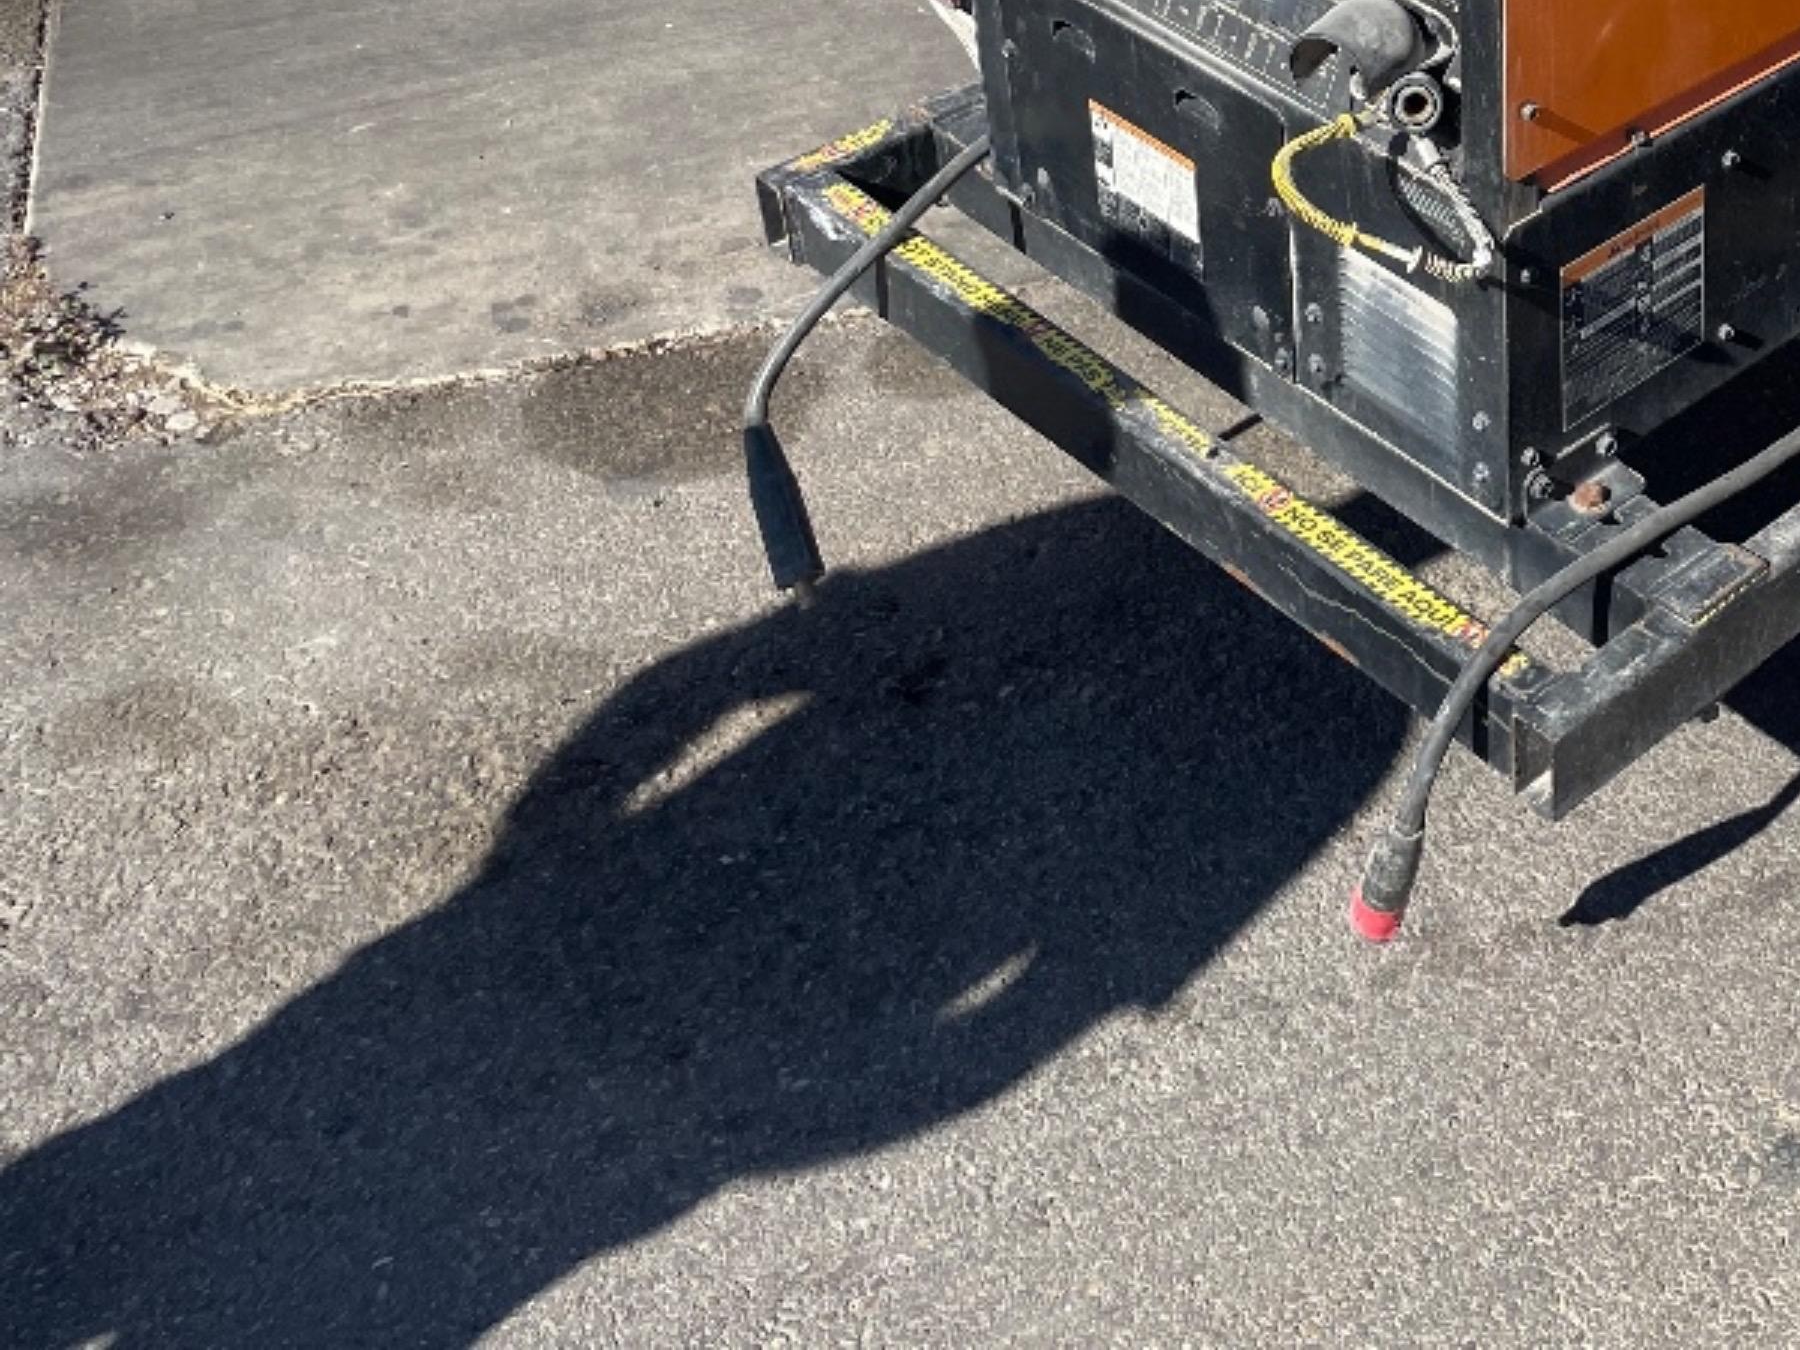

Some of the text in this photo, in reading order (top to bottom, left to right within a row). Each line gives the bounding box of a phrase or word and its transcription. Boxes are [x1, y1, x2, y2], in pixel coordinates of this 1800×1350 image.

[1283, 506, 1318, 532] NO
[1315, 529, 1341, 553] SE
[1343, 546, 1405, 593] PARE
